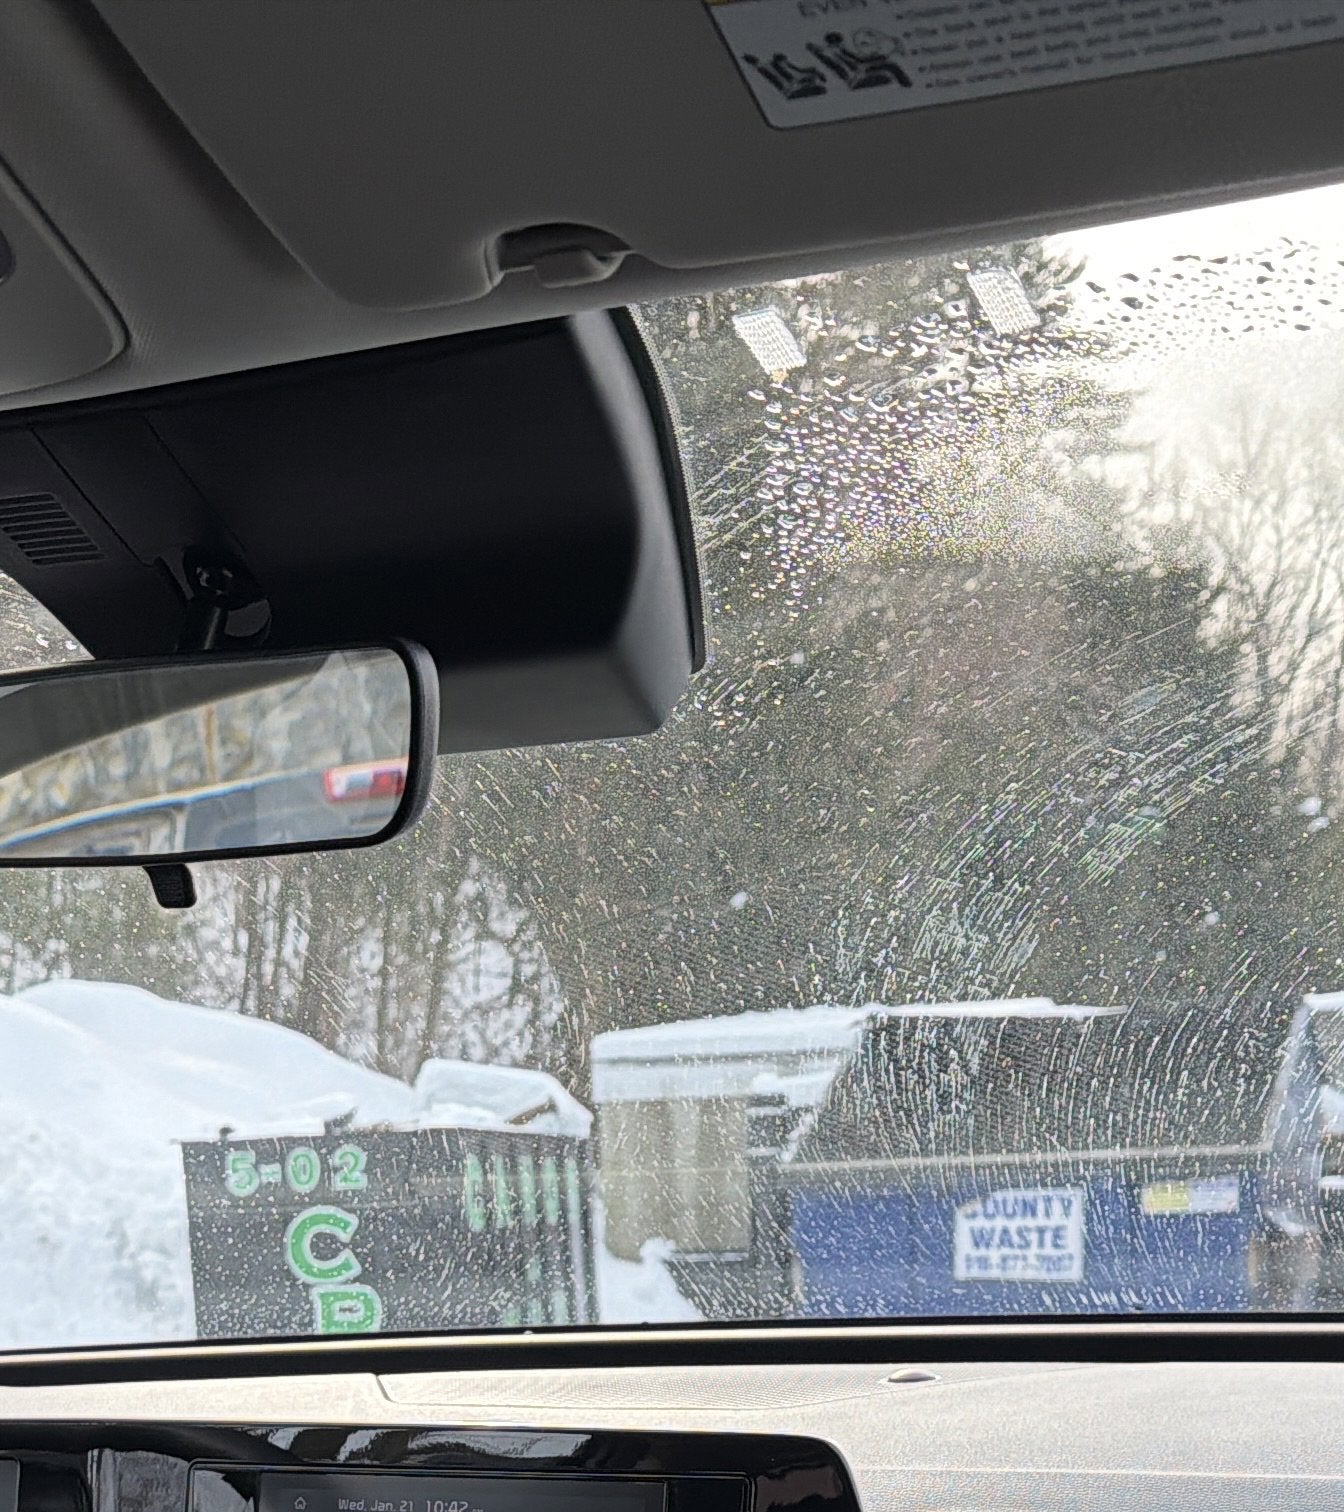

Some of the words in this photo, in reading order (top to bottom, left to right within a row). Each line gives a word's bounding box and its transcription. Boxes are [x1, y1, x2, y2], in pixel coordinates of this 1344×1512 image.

[969, 1226, 1068, 1250] WASTE
[370, 1499, 396, 1512] Jan.
[399, 1500, 414, 1512] 21
